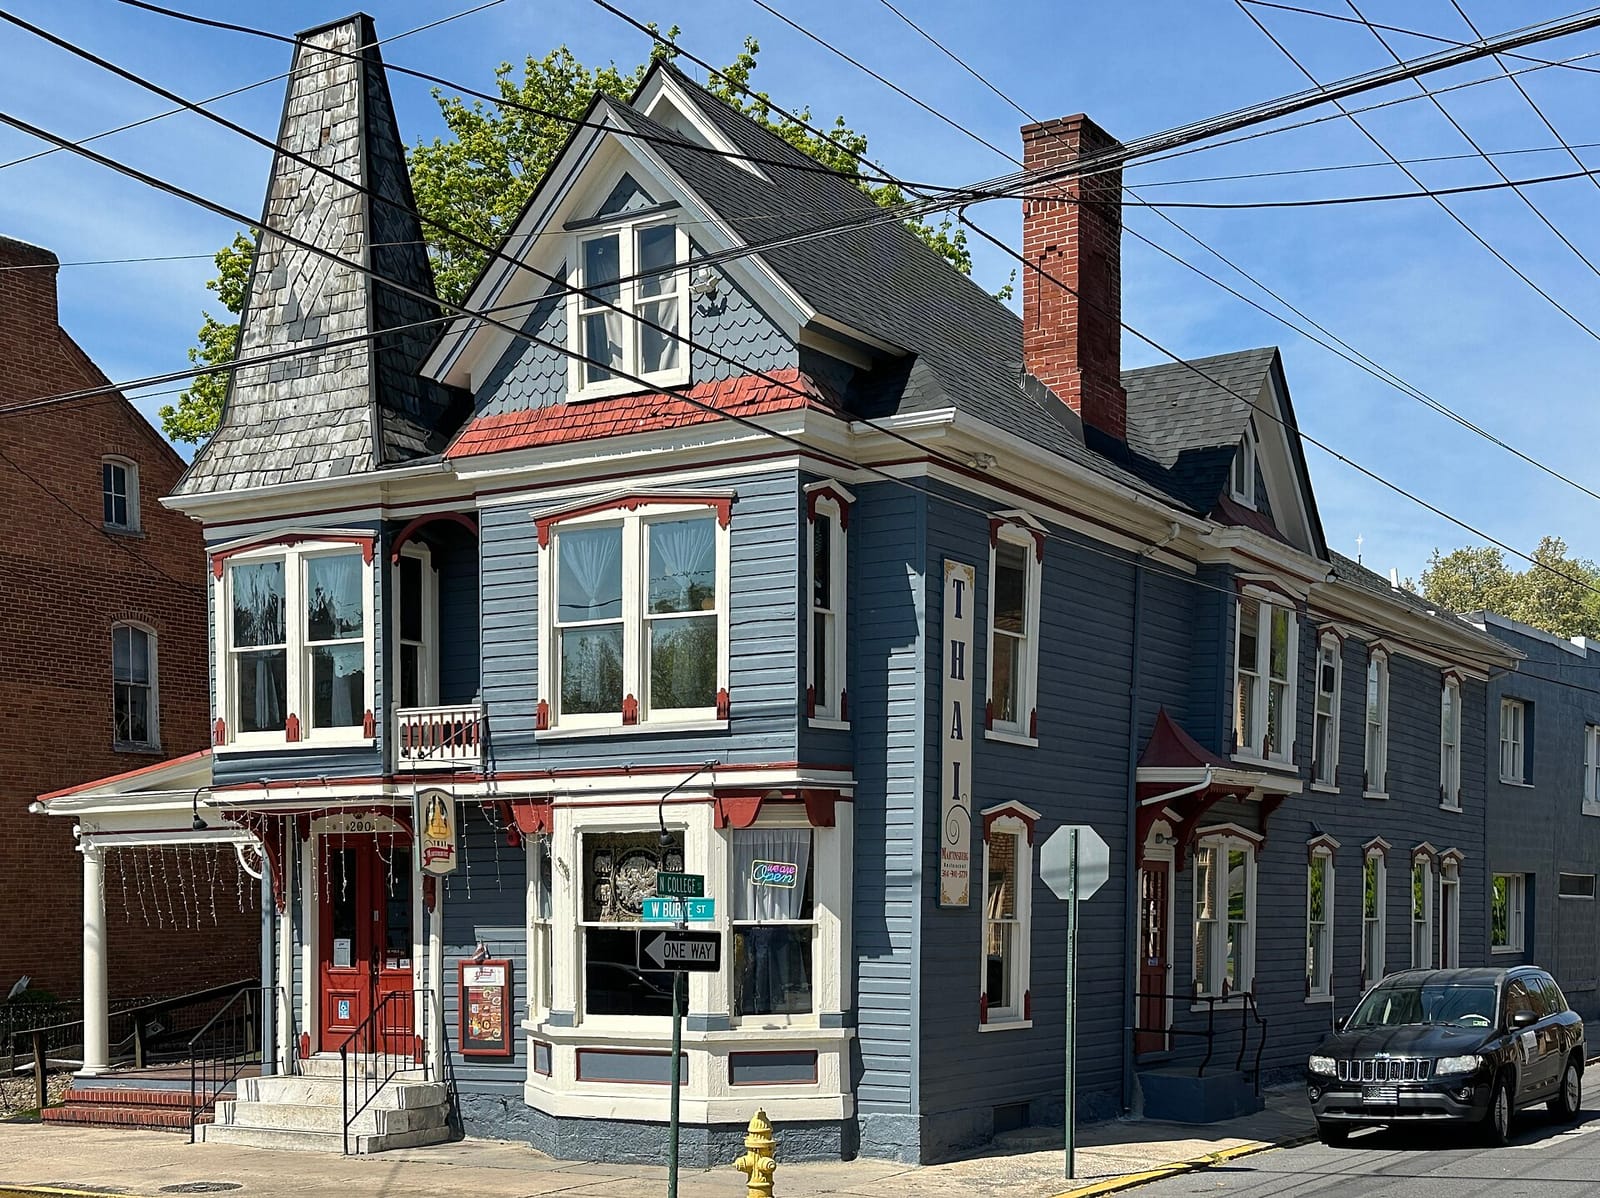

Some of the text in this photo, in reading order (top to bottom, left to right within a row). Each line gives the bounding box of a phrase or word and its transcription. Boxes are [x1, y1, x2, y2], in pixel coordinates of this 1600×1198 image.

[950, 579, 965, 801] THAI
[350, 821, 371, 832] 200
[753, 863, 795, 886] Open
[659, 877, 665, 892] N
[667, 877, 696, 894] COLLEGE
[651, 901, 660, 918] W
[696, 905, 706, 914] ST
[663, 942, 713, 959] ONE WAY
